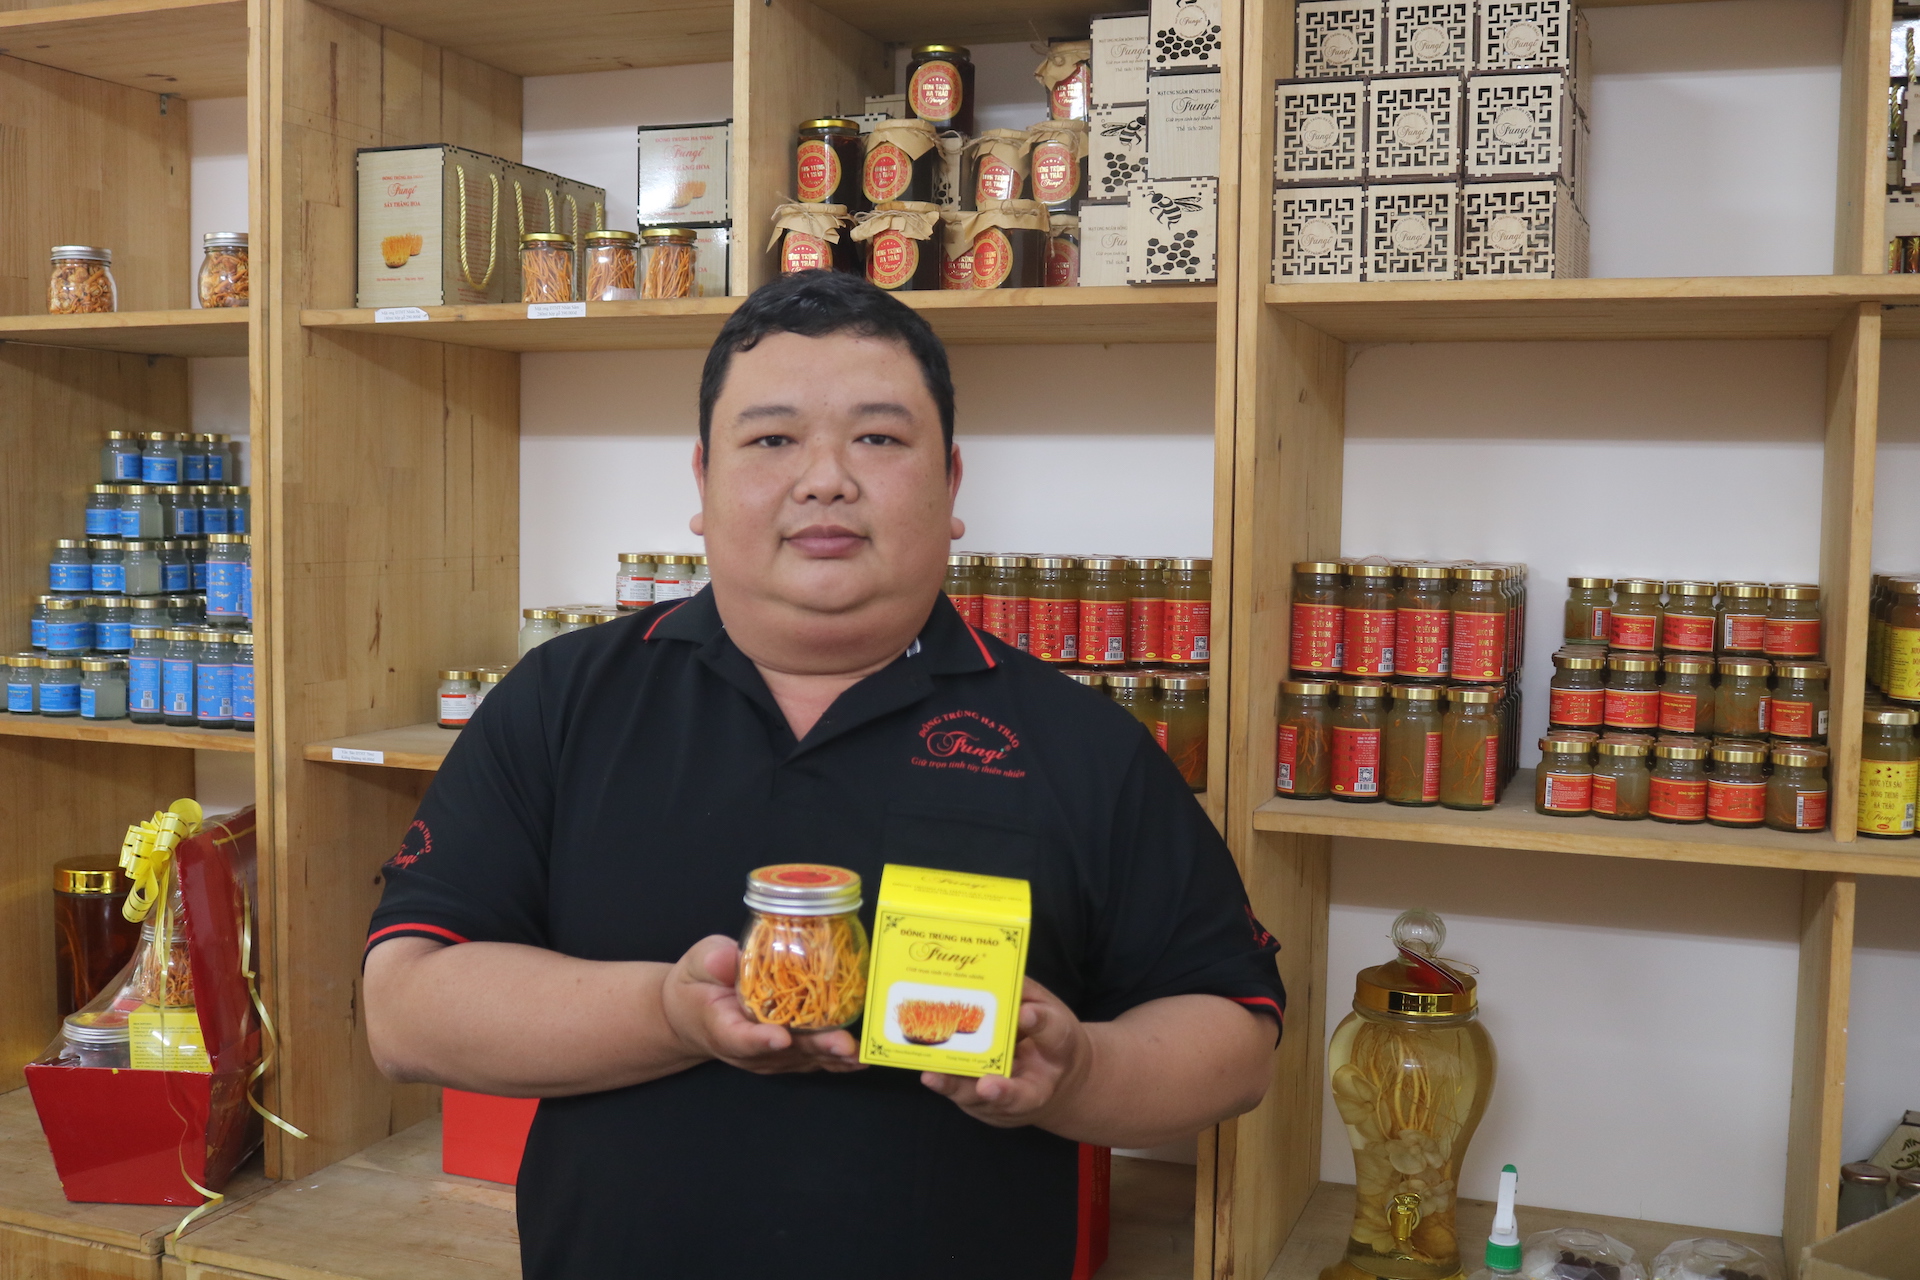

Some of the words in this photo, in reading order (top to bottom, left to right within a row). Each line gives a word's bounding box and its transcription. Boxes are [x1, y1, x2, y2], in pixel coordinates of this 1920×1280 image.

[1110, 44, 1146, 59] Fungi
[1324, 45, 1352, 58] Fungi
[1506, 37, 1538, 51] Fungi
[1171, 97, 1217, 116] Fungi
[1304, 129, 1333, 143] Fungi
[1397, 125, 1427, 139] Fungi
[1495, 122, 1530, 139] Fungi
[664, 145, 705, 162] Fungi
[387, 182, 417, 199] Fungi
[1301, 233, 1332, 248] Fungi
[1395, 230, 1425, 244] Fungi
[918, 716, 943, 738] ĐÔNG
[942, 710, 979, 721] TRÙNG
[980, 717, 996, 728] HẠ
[997, 724, 1020, 748] THẢO
[926, 730, 1007, 764] Fungi
[900, 928, 926, 939] ĐÔNG
[929, 931, 958, 943] TRÙNG
[959, 936, 973, 944] HẠ
[976, 936, 1000, 947] THẢO
[908, 941, 980, 971] Fungi
